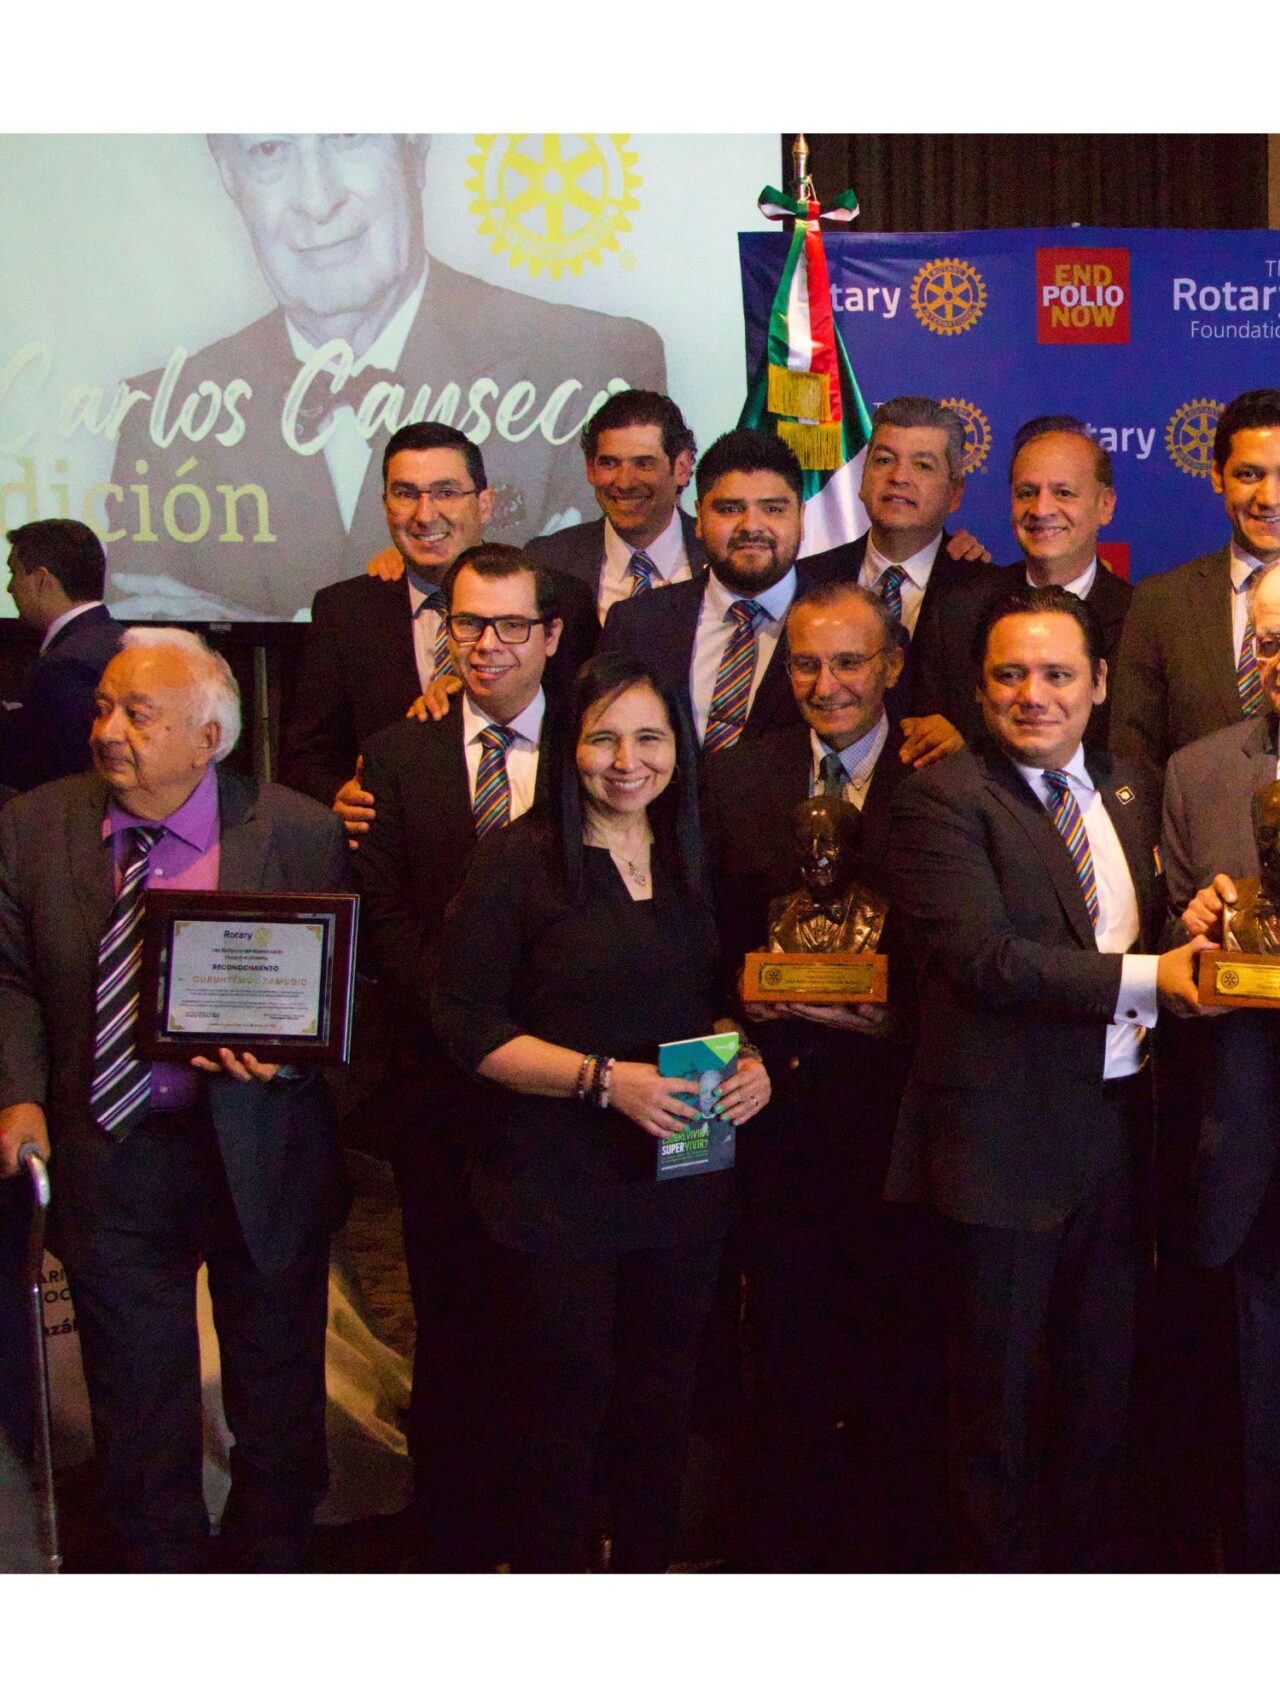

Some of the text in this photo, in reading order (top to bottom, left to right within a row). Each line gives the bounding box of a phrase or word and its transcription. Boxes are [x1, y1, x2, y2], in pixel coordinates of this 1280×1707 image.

[1055, 264, 1112, 287] END
[829, 283, 901, 319] tary
[1042, 285, 1124, 307] POLIO
[1051, 305, 1117, 328] NOW
[0, 456, 277, 543] dición
